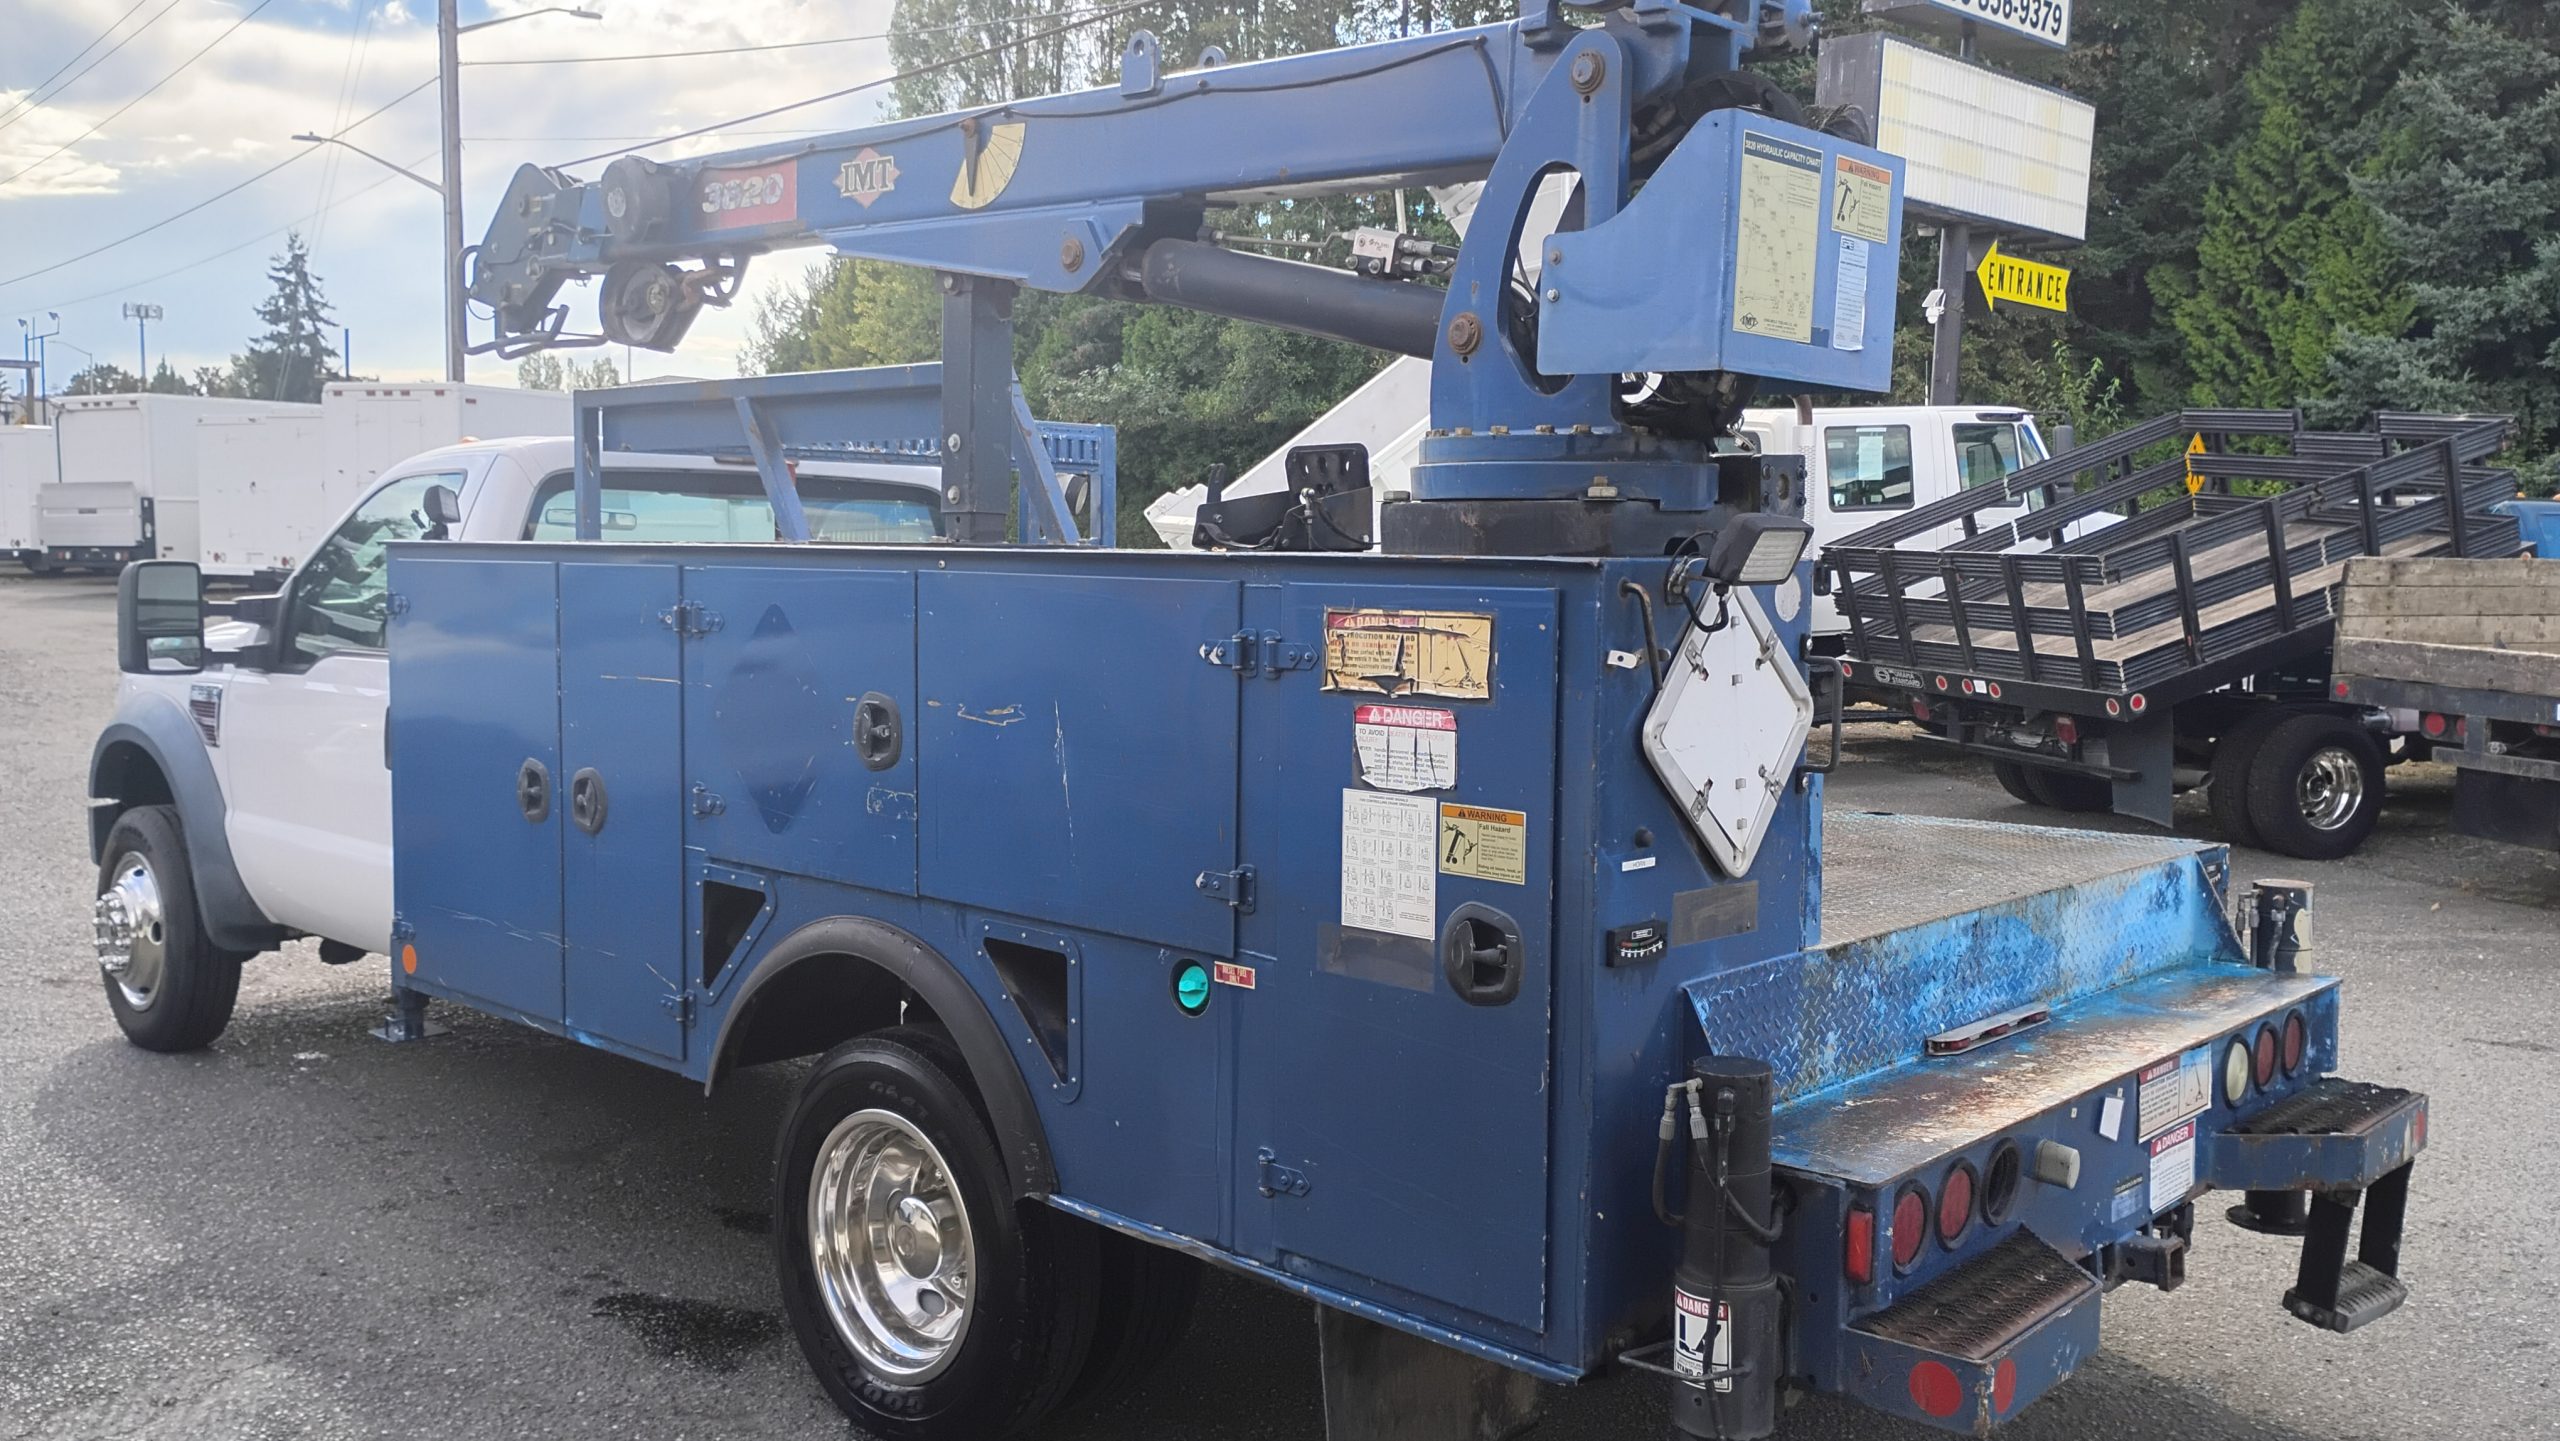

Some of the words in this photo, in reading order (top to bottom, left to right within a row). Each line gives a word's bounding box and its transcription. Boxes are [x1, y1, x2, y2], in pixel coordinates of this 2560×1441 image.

[1756, 143, 1784, 157] HYDRAULIC
[1784, 150, 1806, 163] CAPACITY
[1806, 155, 1821, 168] CHART
[840, 156, 895, 199] IMT
[1988, 262, 2062, 303] ENTRANCE
[1383, 708, 1442, 728] DANGER
[1467, 810, 1508, 823] WARNING
[1490, 825, 1511, 833] Hazard
[2162, 1126, 2189, 1149] DANGER
[1683, 1299, 1725, 1318] DANGR
